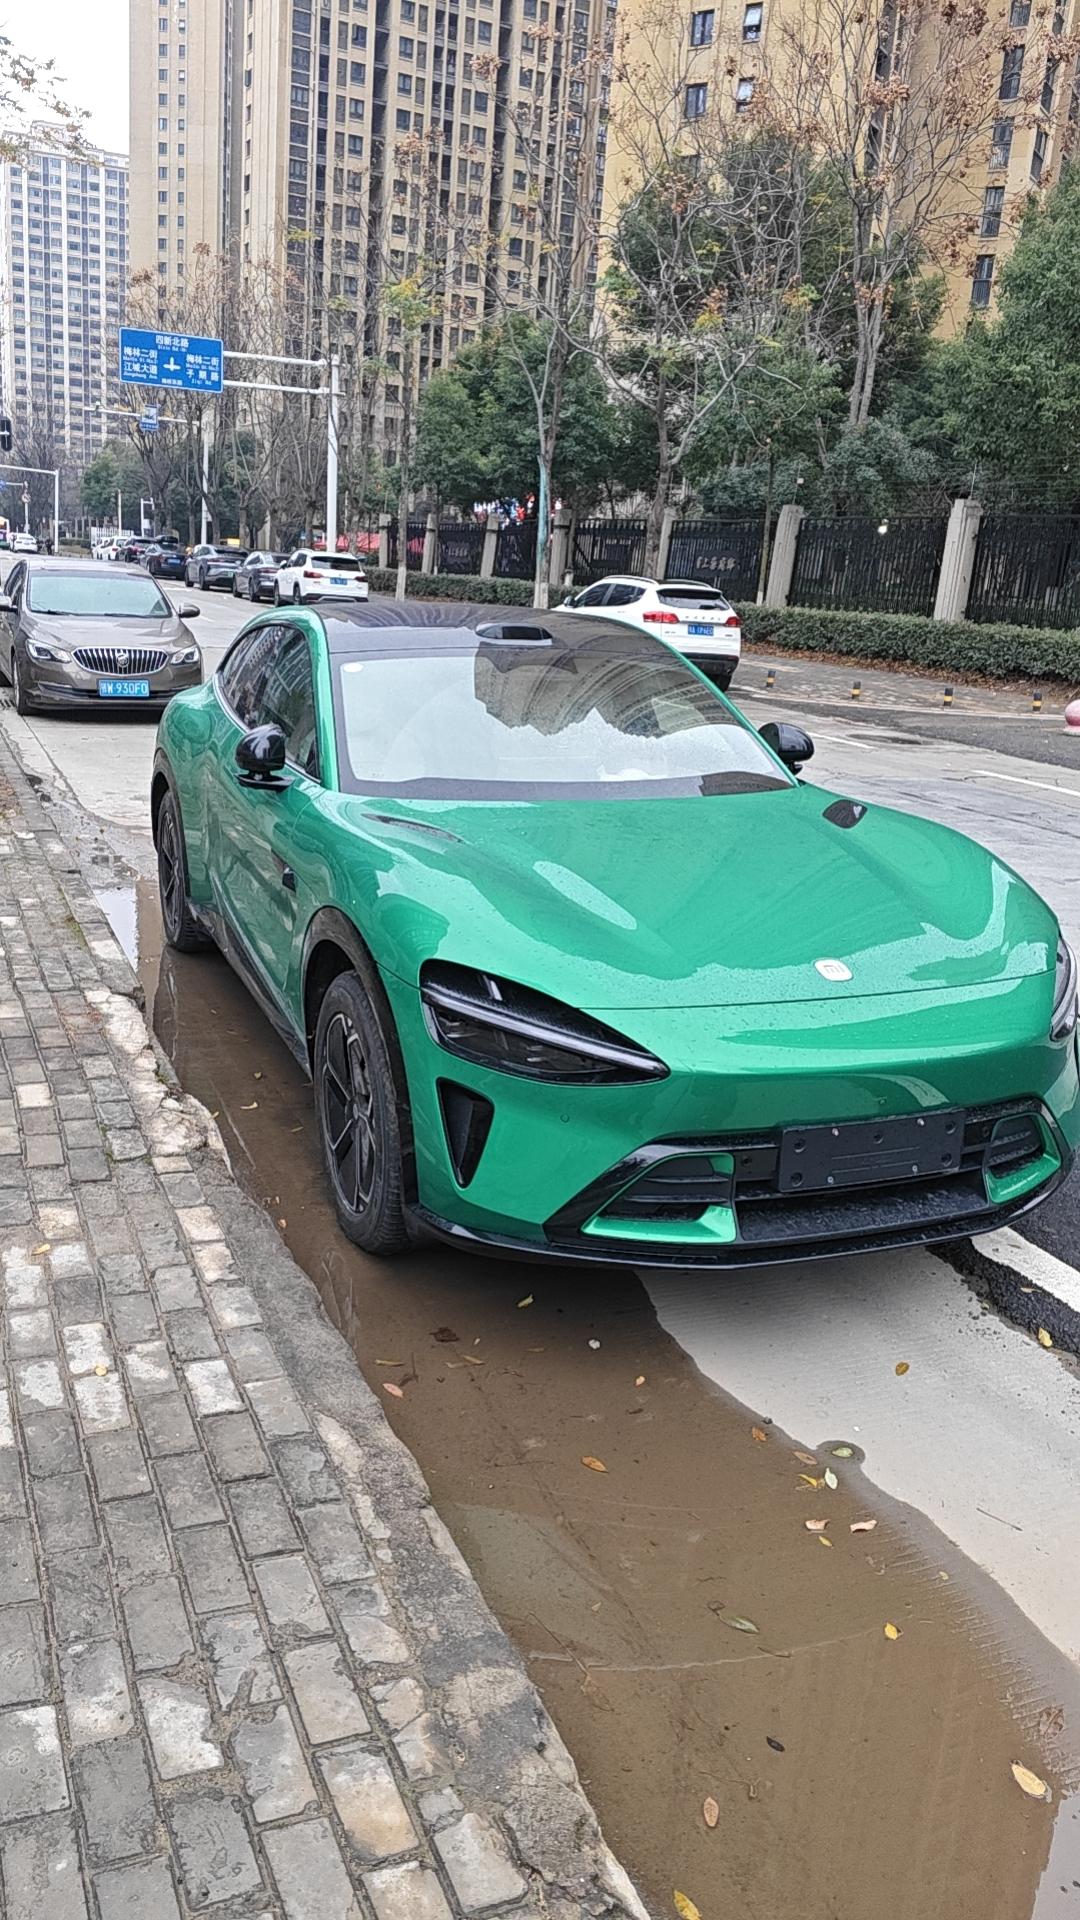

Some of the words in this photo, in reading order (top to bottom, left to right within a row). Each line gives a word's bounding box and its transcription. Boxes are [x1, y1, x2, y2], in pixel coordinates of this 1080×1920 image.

[155, 335, 189, 348] 四新北路
[123, 347, 158, 359] 梅林二街
[186, 354, 219, 366] 梅林二街
[124, 362, 158, 375] 江城大道
